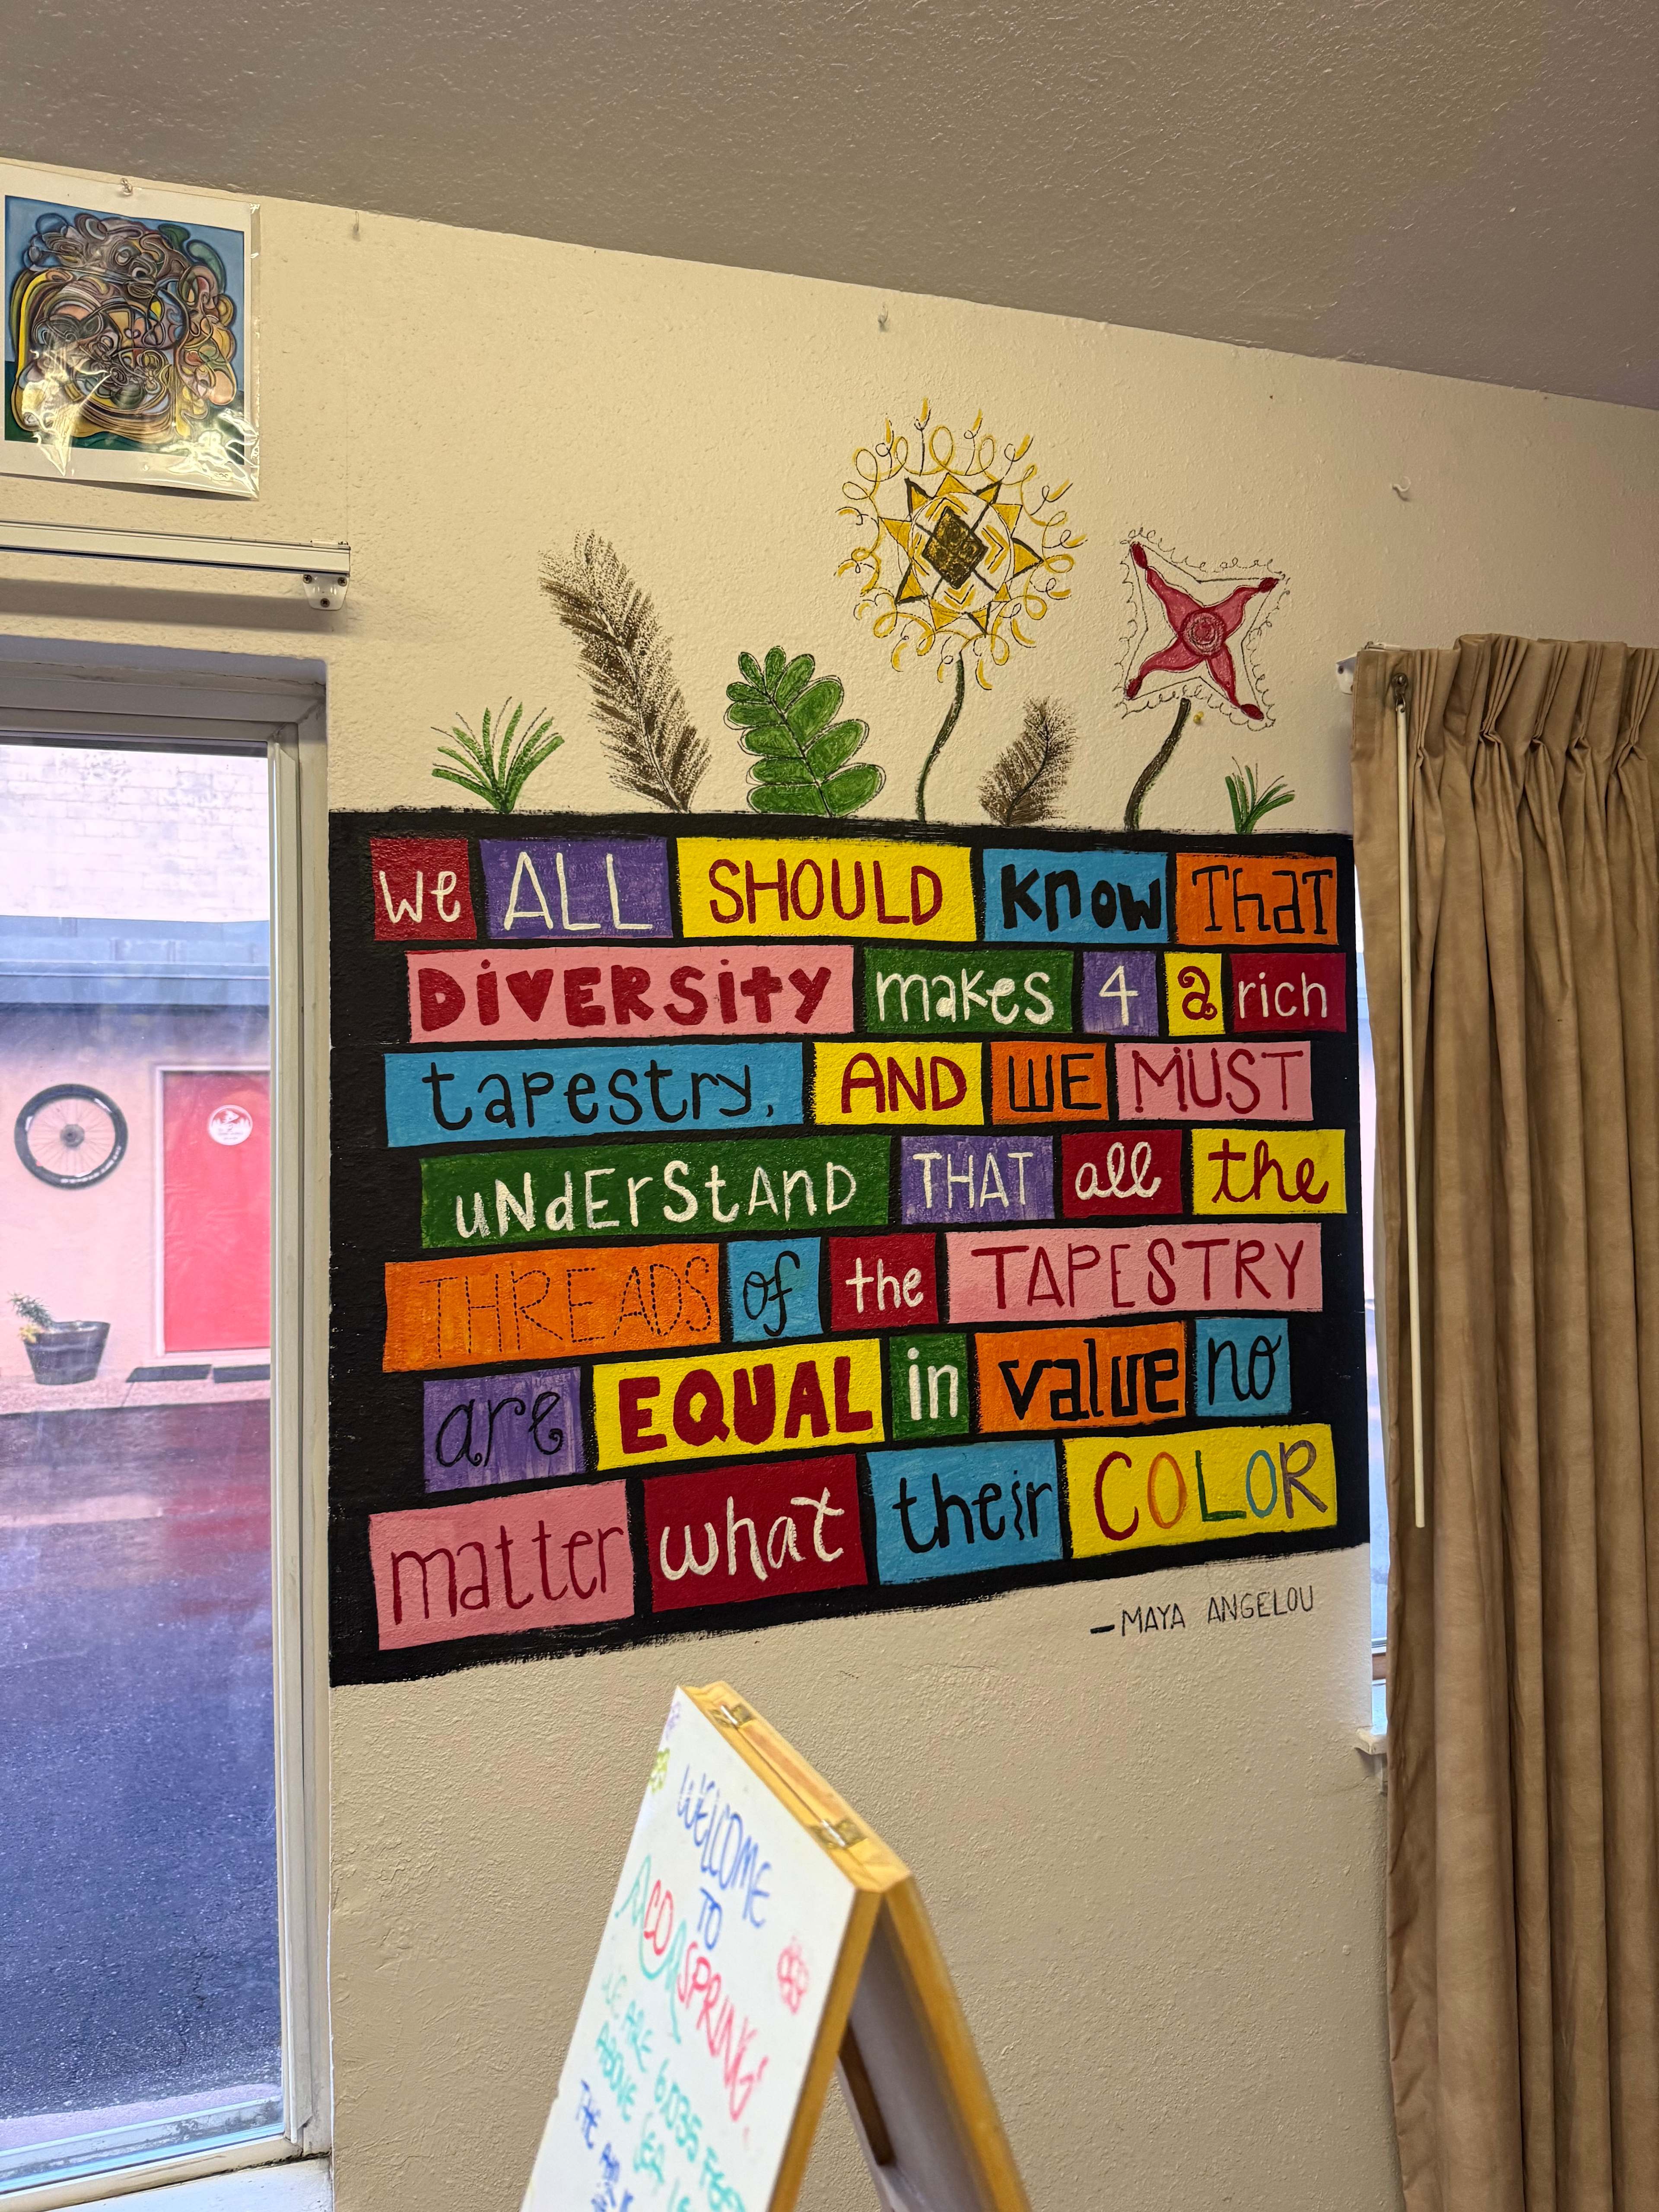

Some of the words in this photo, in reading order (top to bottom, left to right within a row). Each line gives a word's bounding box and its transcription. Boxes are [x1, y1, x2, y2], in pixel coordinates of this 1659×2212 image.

[503, 851, 653, 931] ALL
[709, 858, 943, 926] SHOULD
[1098, 965, 1139, 1027] 4
[1177, 965, 1218, 1021] a
[1237, 972, 1328, 1020] rich
[841, 1052, 967, 1114] AND
[1008, 1052, 1103, 1112] WE
[1131, 1046, 1304, 1115] MUST
[912, 1151, 1034, 1209] THAT
[1074, 1141, 1162, 1201] all
[1208, 1138, 1329, 1205] the
[419, 1255, 712, 1360] THREADS
[845, 1257, 924, 1314] the
[970, 1237, 1304, 1309] TAPESTRY
[435, 1391, 563, 1467] are
[618, 1356, 874, 1455] EQUAL
[907, 1347, 958, 1421] in
[998, 1338, 1180, 1421] value
[1208, 1335, 1282, 1406] no
[391, 1519, 625, 1626] matter
[660, 1487, 845, 1582] what
[891, 1470, 1053, 1554] their
[1093, 1439, 1328, 1541] COLOR
[1208, 1585, 1314, 1624] ANGELOU
[677, 1764, 772, 1928] WELCOME
[696, 1885, 723, 1951] TO
